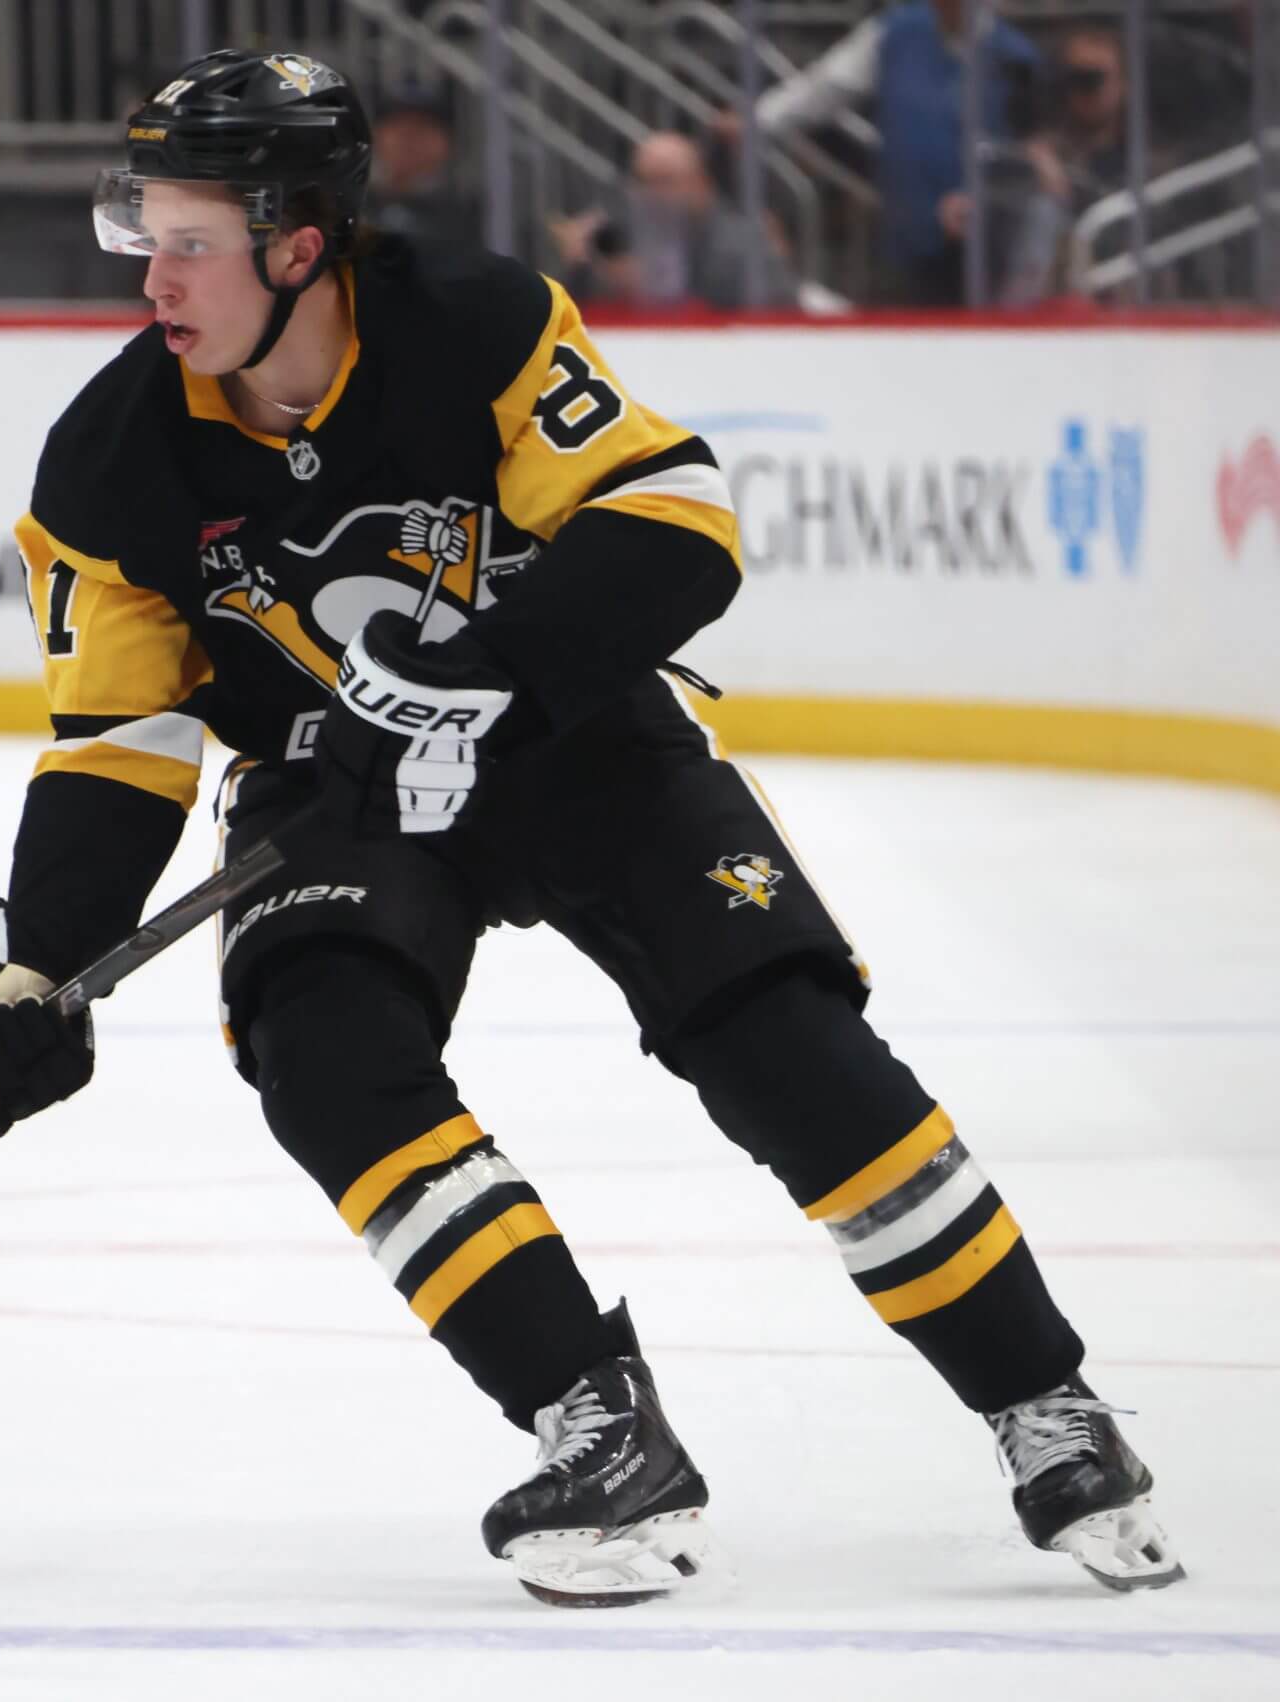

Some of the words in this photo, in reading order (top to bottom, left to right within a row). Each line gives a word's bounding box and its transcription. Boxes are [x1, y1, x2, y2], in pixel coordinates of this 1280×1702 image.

[153, 79, 195, 106] 81
[730, 454, 1035, 578] GHMARK
[337, 655, 481, 734] AUER
[603, 1451, 646, 1495] BAUER
